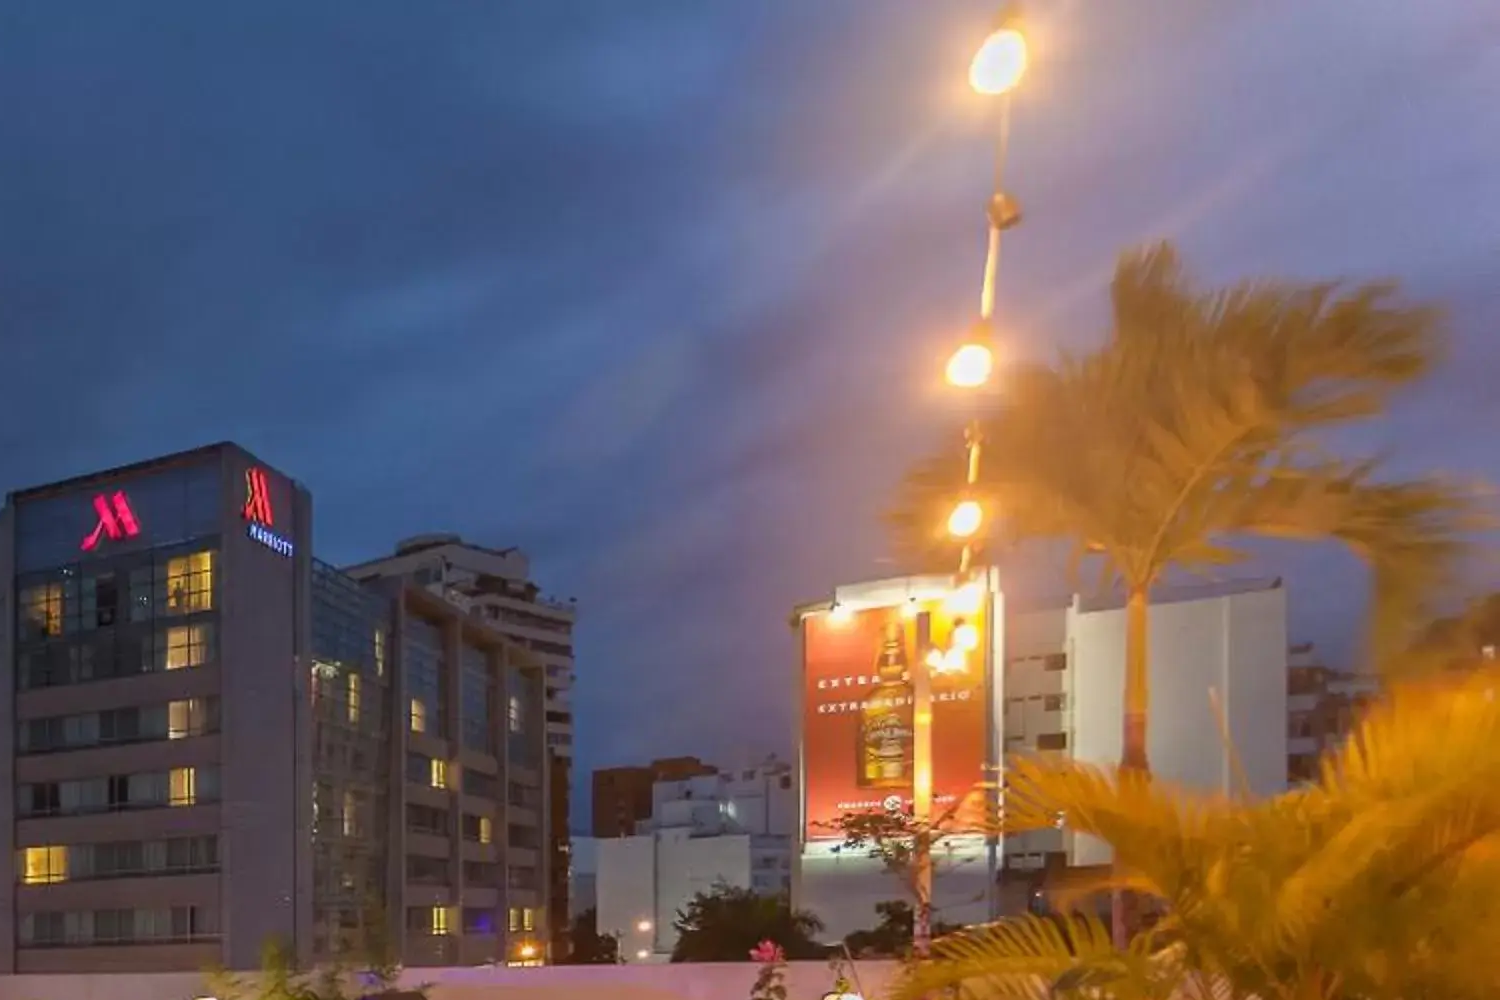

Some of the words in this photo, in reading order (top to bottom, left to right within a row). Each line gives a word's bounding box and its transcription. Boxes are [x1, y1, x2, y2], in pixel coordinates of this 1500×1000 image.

[249, 522, 294, 558] MARRIOTT
[817, 674, 882, 689] EXTRA
[818, 691, 970, 713] EXTRARDIARIO
